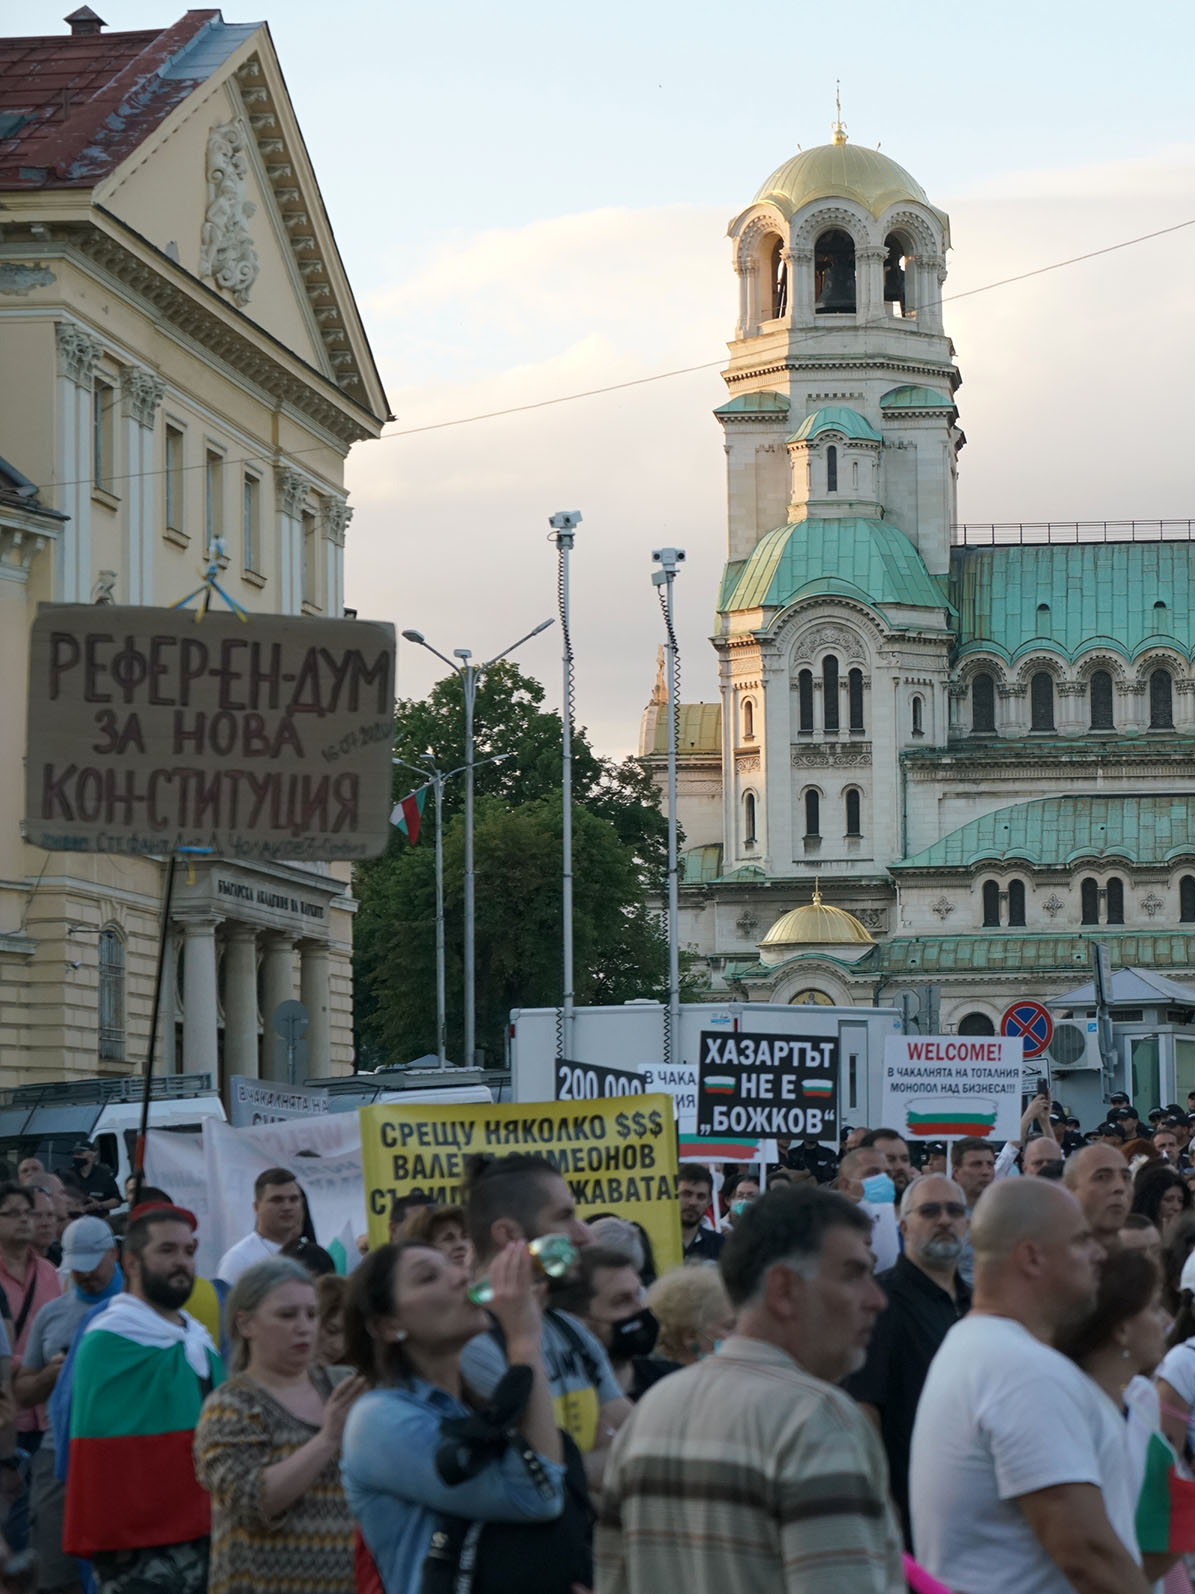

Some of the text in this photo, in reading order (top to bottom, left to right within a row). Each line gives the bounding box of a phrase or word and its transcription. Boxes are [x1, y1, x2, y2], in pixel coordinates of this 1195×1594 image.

[93, 710, 306, 759] ЗА НОВА
[704, 1038, 835, 1068] ХАЗАРТЪТ
[907, 1043, 1003, 1061] WELCOME!
[740, 1073, 796, 1100] НЕ Е
[887, 1067, 1020, 1079] В ЧАКАЛНЯТА НА ТОТАЛНИЯ
[890, 1082, 938, 1093] МОНОПОЛ
[940, 1083, 961, 1095] НАД
[963, 1083, 1016, 1095] БИЗНЕСА!!!
[381, 1119, 475, 1150] СРЕЩУ
[485, 1114, 606, 1145] НЯКОЛКО
[616, 1110, 663, 1139] $$$
[700, 1105, 835, 1136] „БОЖКОВ“
[393, 1151, 497, 1181] ВАЛЕ
[508, 1143, 656, 1174] МЕОНОВ
[573, 1175, 681, 1206] ЖАВАТА!
